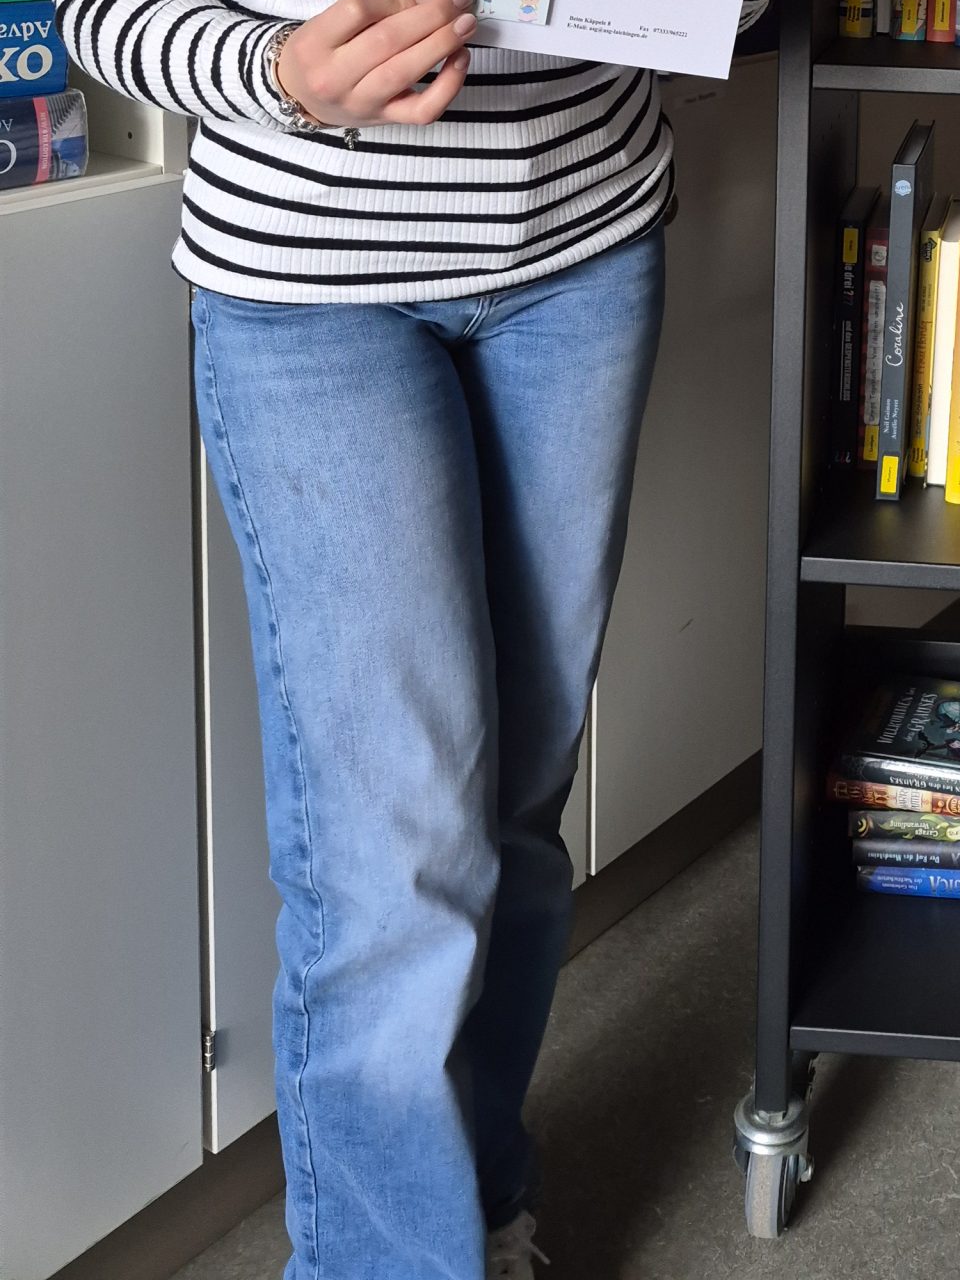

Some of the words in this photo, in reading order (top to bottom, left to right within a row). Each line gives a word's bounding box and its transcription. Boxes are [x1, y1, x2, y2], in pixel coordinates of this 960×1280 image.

[886, 302, 905, 367] Coraline
[889, 819, 929, 829] Verwandlung
[914, 828, 939, 837] Carags
[902, 853, 914, 861] des
[915, 853, 929, 863] Ruf
[930, 854, 941, 864] Der
